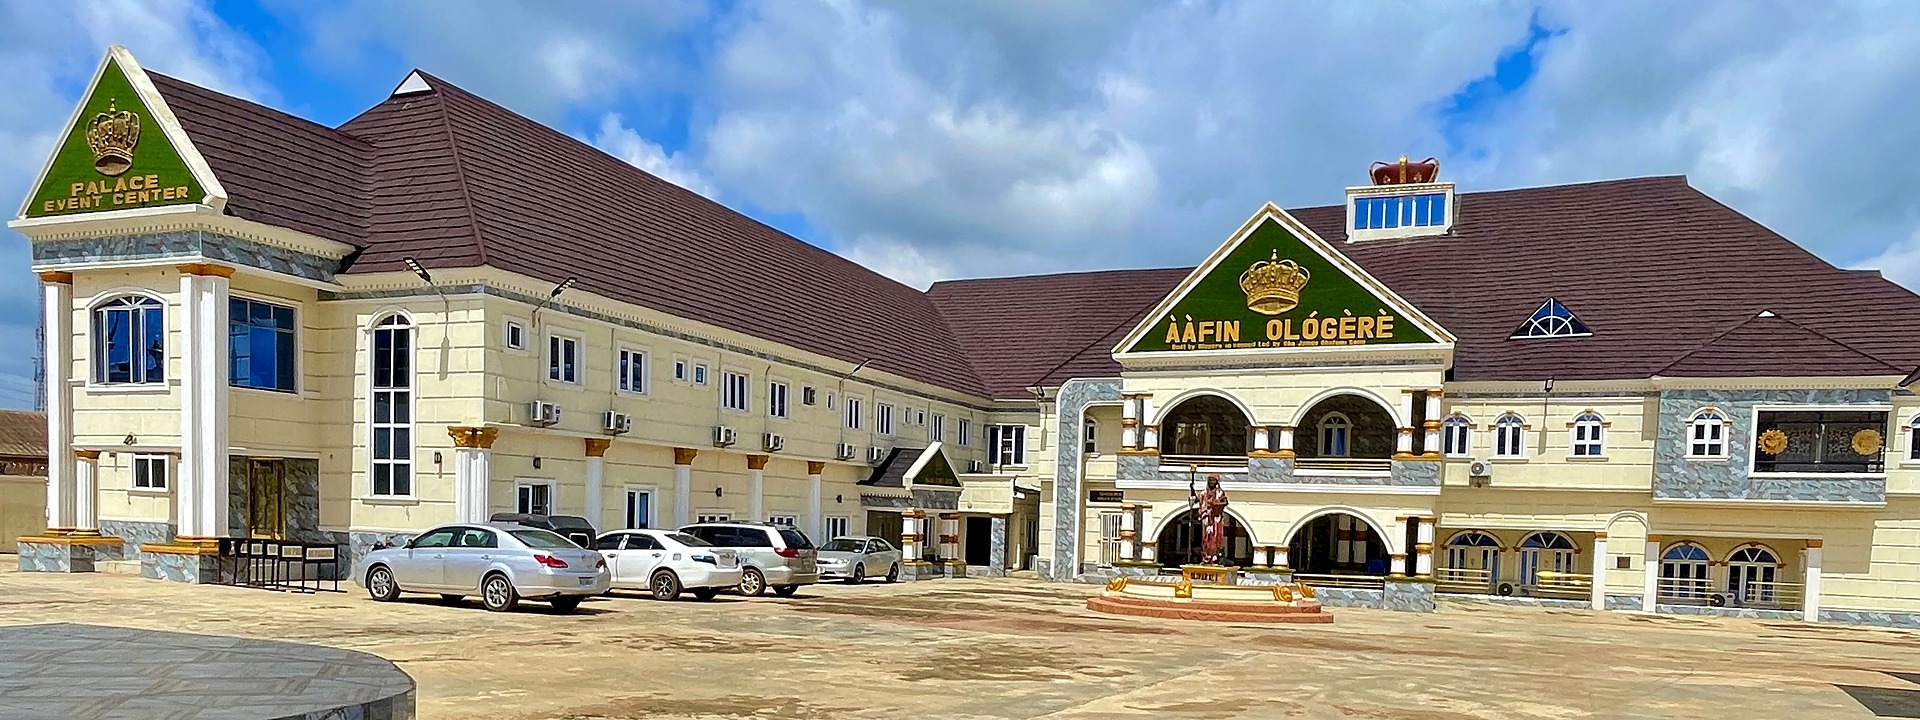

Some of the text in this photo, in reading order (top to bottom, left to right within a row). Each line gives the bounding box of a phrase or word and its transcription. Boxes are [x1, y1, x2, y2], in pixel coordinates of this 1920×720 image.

[71, 174, 159, 197] PALACE
[44, 186, 189, 212] EVENT CENTER
[1165, 308, 1394, 343] ÀÀFIN OLÓGÈRÈ
